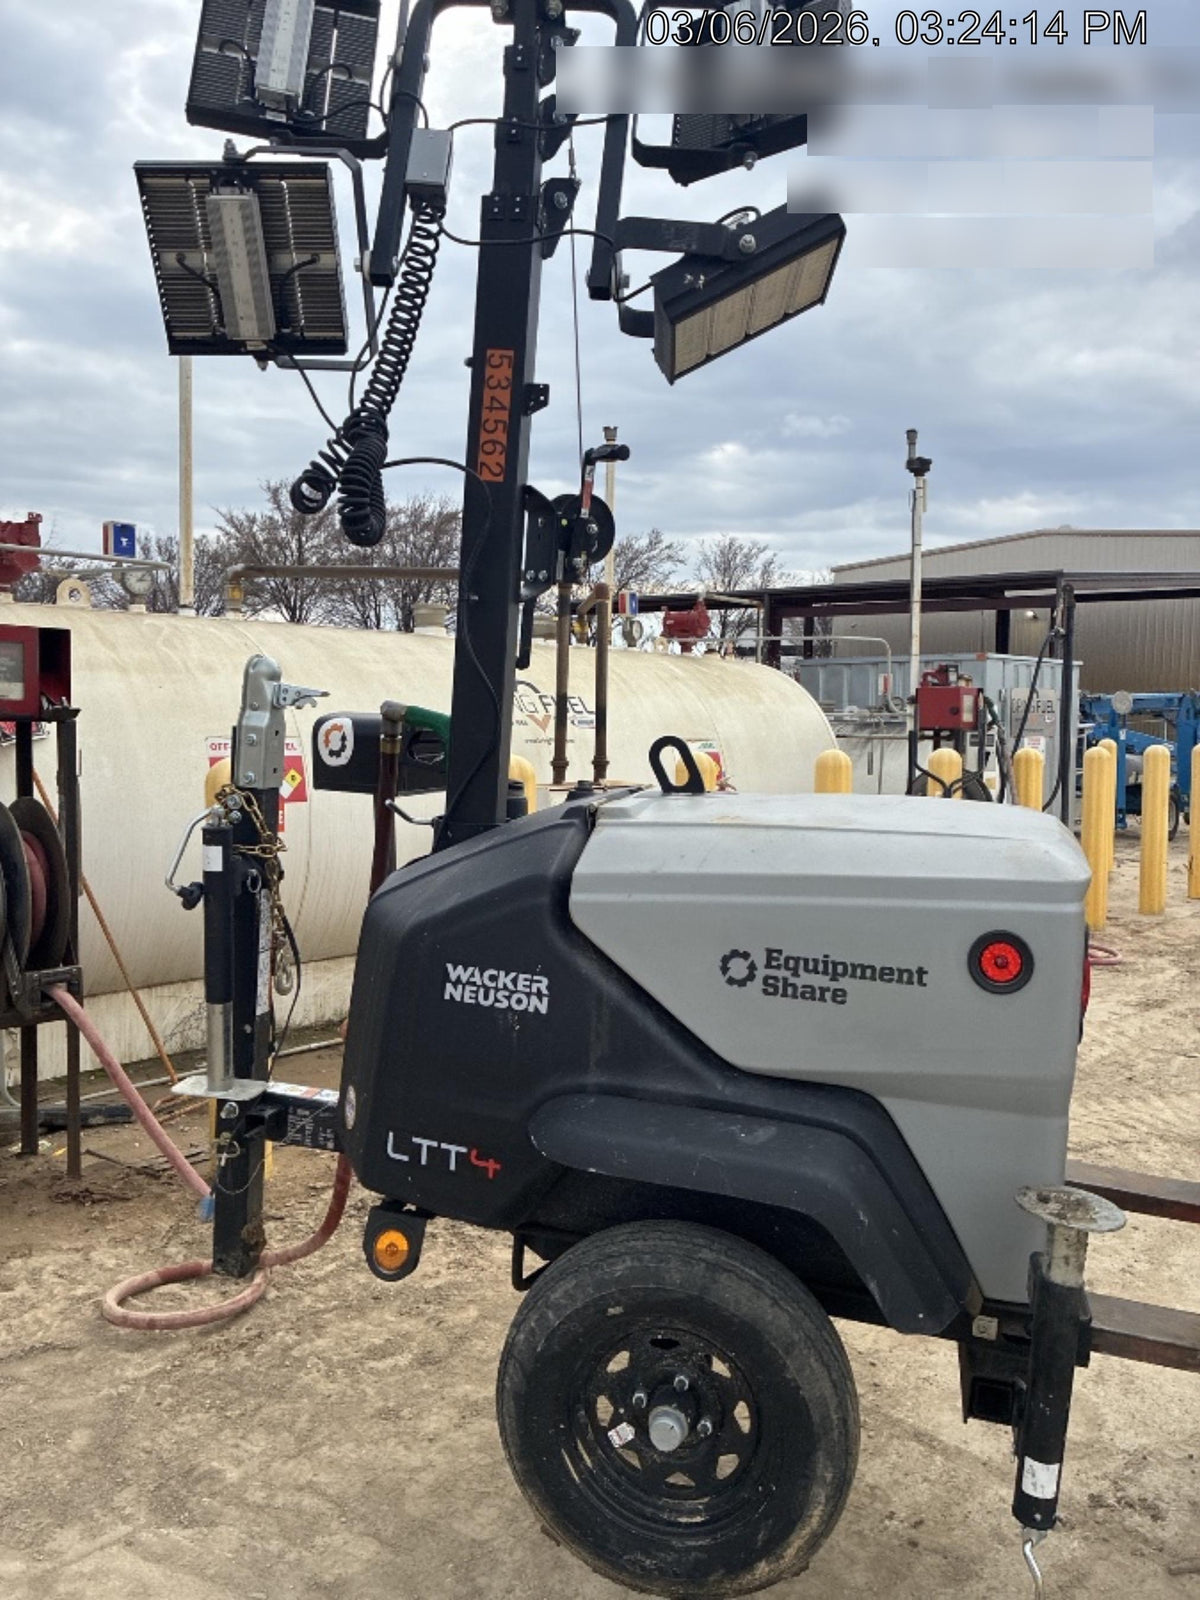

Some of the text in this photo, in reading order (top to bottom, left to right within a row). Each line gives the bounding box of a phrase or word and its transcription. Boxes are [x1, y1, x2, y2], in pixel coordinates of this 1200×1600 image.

[479, 353, 513, 477] 534562
[539, 695, 596, 715] FEL
[445, 962, 550, 995] WACKER
[764, 947, 929, 987] Equipment
[443, 982, 550, 1015] NEUSON
[762, 975, 848, 1005] Share
[386, 1130, 502, 1180] LTT4
